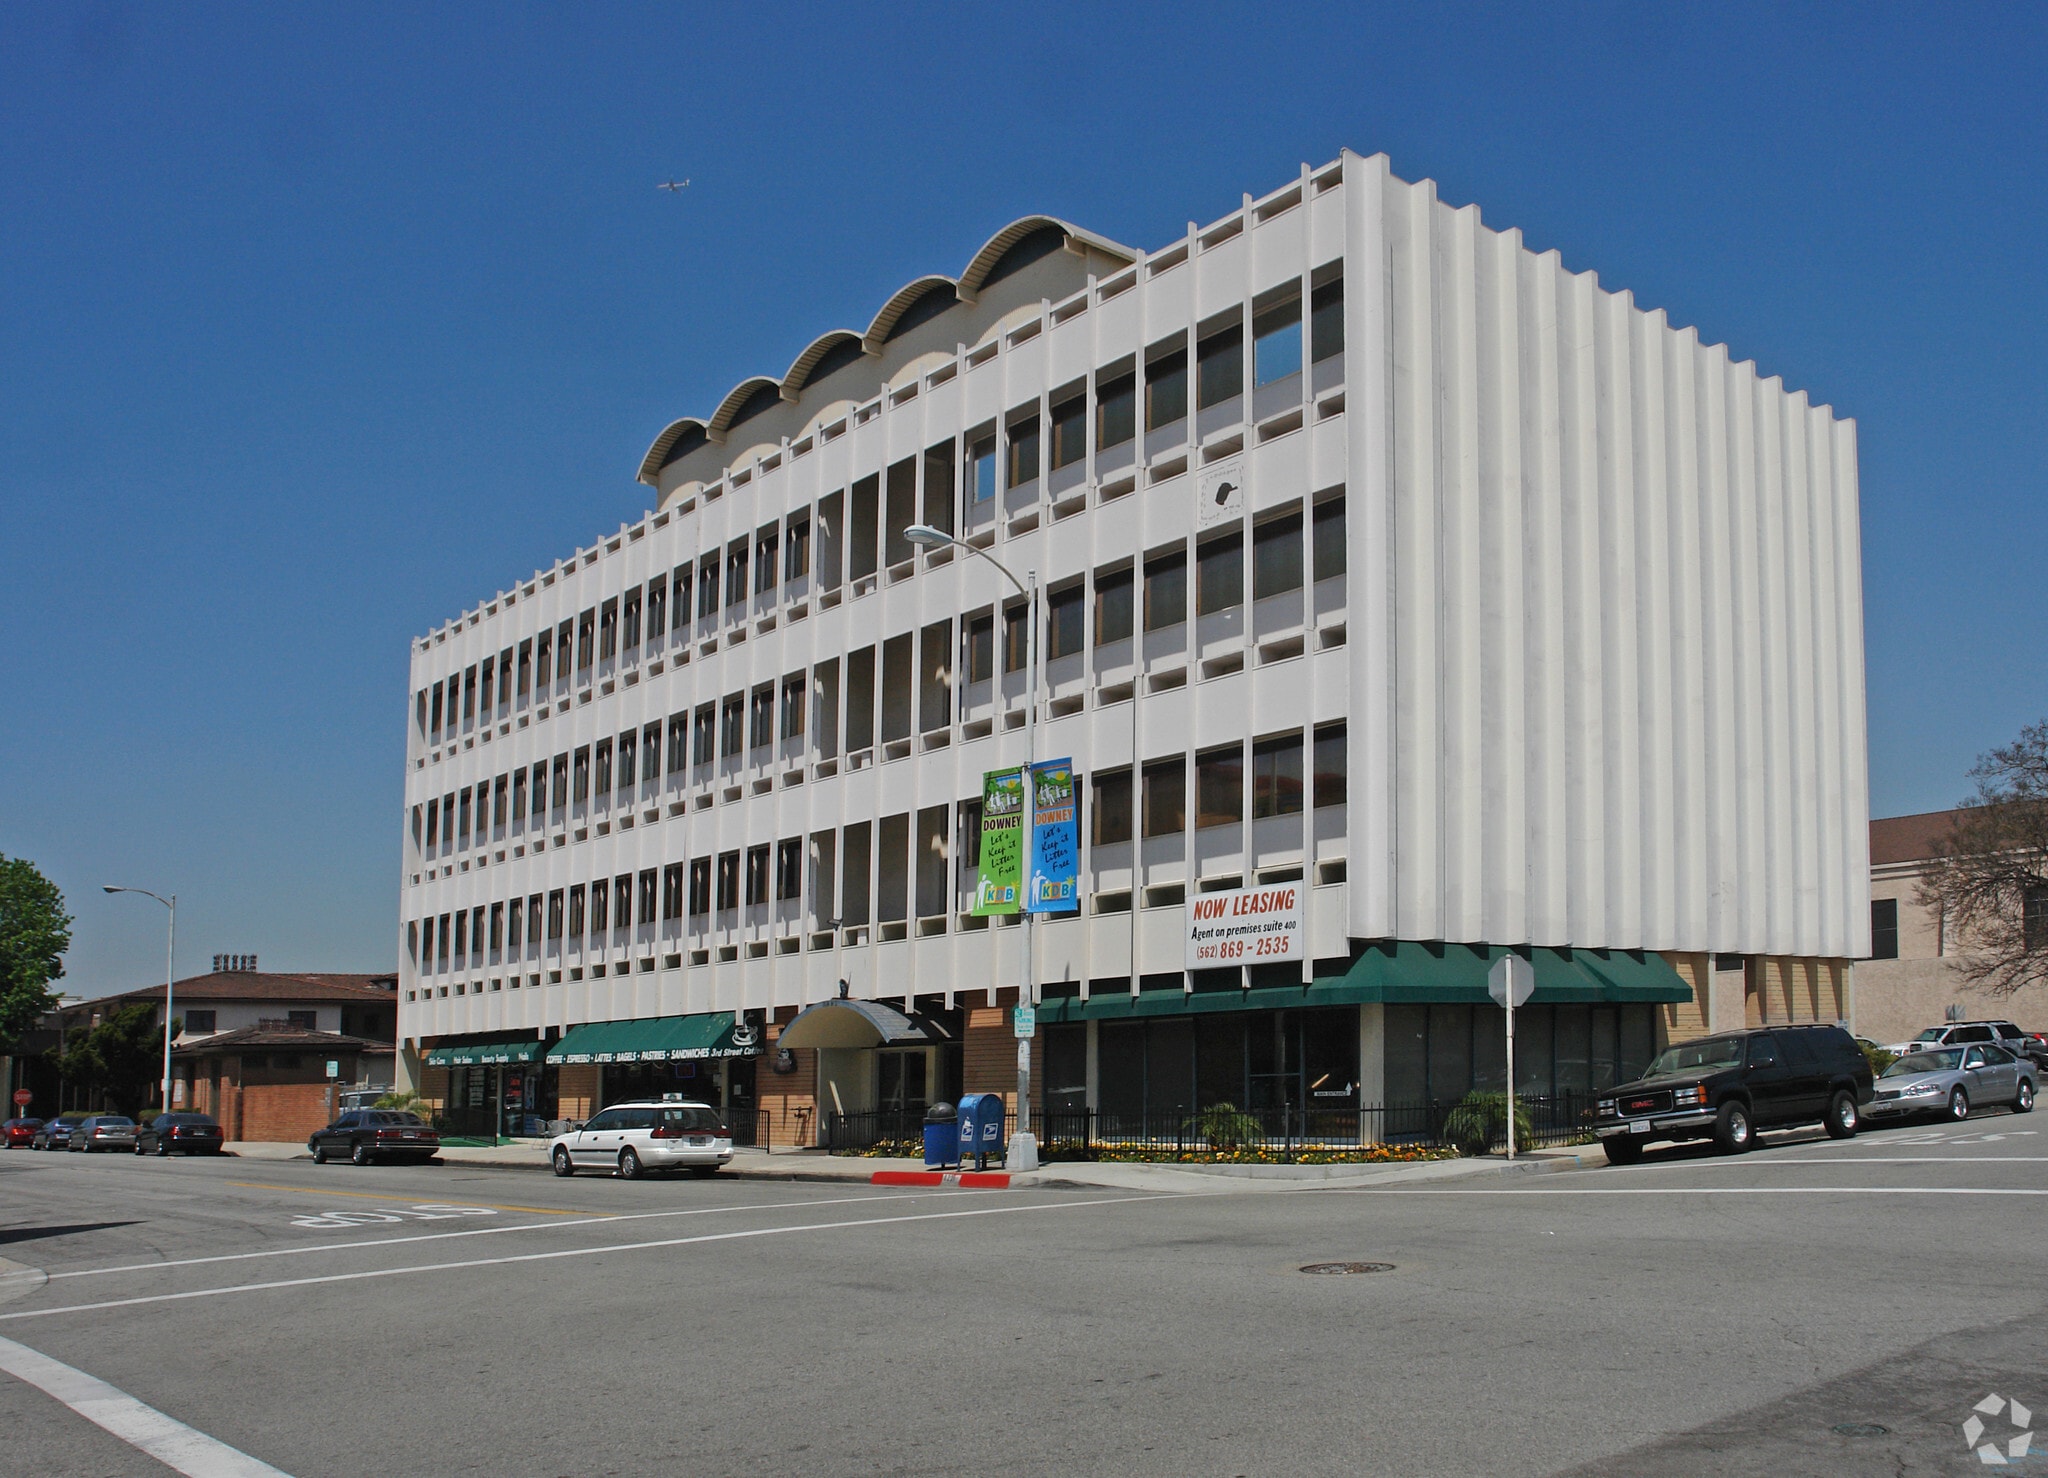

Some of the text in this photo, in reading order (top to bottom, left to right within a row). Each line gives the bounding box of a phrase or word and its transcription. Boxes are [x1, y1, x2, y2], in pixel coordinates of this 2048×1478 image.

[984, 816, 1022, 831] DOWNEY
[1036, 808, 1073, 826] DOWNEY
[990, 832, 1009, 846] Let's
[1043, 825, 1061, 840] Let's
[988, 840, 1016, 857] Keep it
[1042, 834, 1068, 852] Keep it
[992, 856, 1014, 868] Litter
[1045, 850, 1068, 864] Litter
[998, 866, 1015, 878] Free
[1052, 860, 1070, 872] Free
[988, 888, 1013, 901] KDB
[1042, 884, 1069, 898] KDB
[1194, 888, 1295, 920] NOW LEASING
[1191, 920, 1296, 941] Agent on premises suite 400
[1196, 944, 1218, 960] (562)
[1220, 940, 1244, 959] 869
[1256, 936, 1289, 956] 2535
[546, 1047, 710, 1064] COFFEE ESPRESSO LATTES BAGELS PASTRIES SANDWICHES
[711, 1048, 722, 1057] 3rd
[723, 1047, 743, 1056] Street
[1631, 1100, 1654, 1108] GMC
[290, 1204, 498, 1228] STOP
